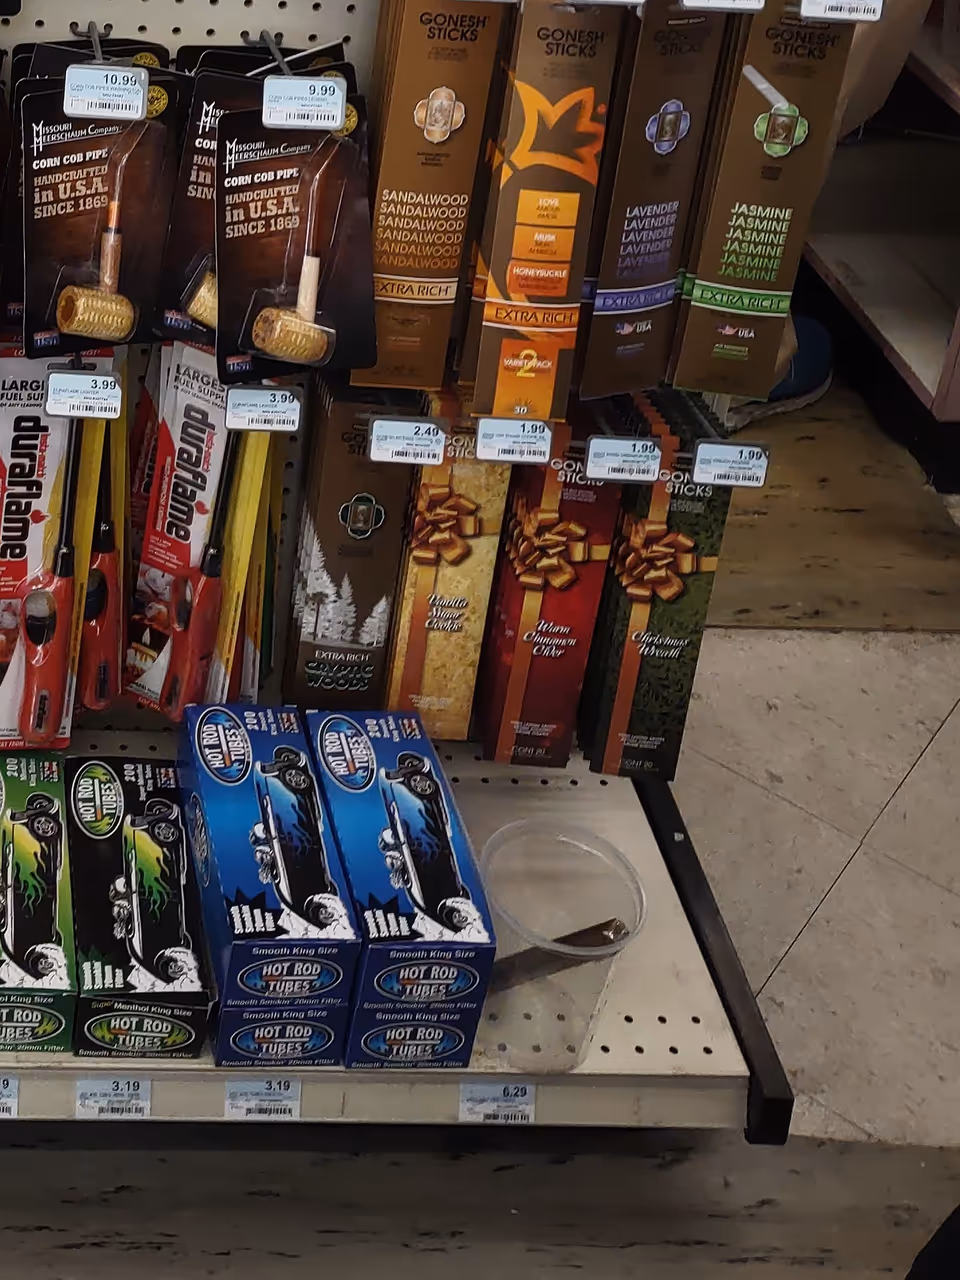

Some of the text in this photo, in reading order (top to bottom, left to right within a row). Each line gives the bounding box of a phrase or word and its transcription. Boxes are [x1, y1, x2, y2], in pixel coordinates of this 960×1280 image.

[309, 85, 335, 96] 9.99
[382, 189, 468, 205] SANDALWOOD
[626, 201, 680, 217] LAVENDER
[731, 201, 793, 220] JASMINE
[513, 266, 567, 278] HONEYSUCKLE
[495, 308, 576, 323] EXTRA RICH
[520, 424, 546, 434] 1.99
[738, 449, 763, 461] 1.99
[535, 619, 571, 635] Warm
[9, 995, 32, 1005] King
[34, 995, 54, 1004] Size
[502, 1085, 528, 1097] 6.29
